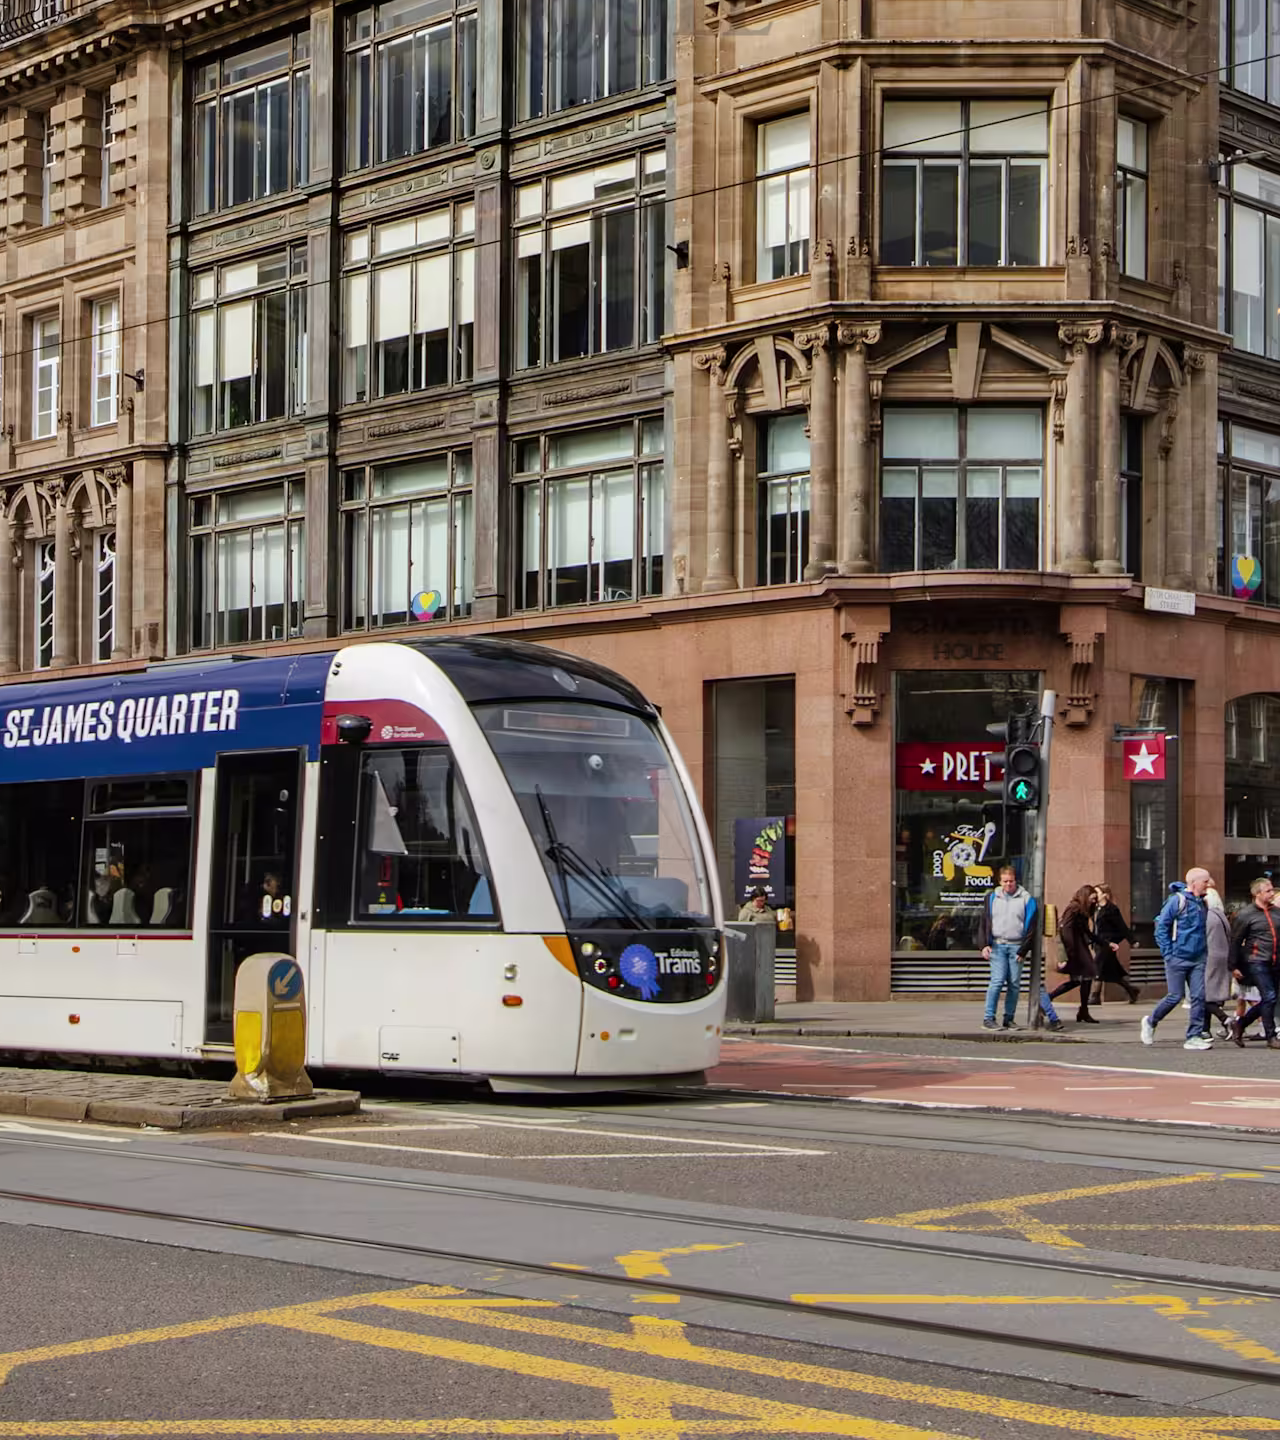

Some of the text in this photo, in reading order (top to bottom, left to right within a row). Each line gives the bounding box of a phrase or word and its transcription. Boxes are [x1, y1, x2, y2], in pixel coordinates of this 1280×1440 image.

[3, 689, 240, 749] ST JAMES QUARTER
[943, 751, 993, 781] PRET
[957, 824, 985, 838] Feel
[933, 850, 944, 877] Good
[965, 876, 993, 886] Food.
[654, 952, 701, 974] Trams
[670, 948, 699, 958] Edinburgh
